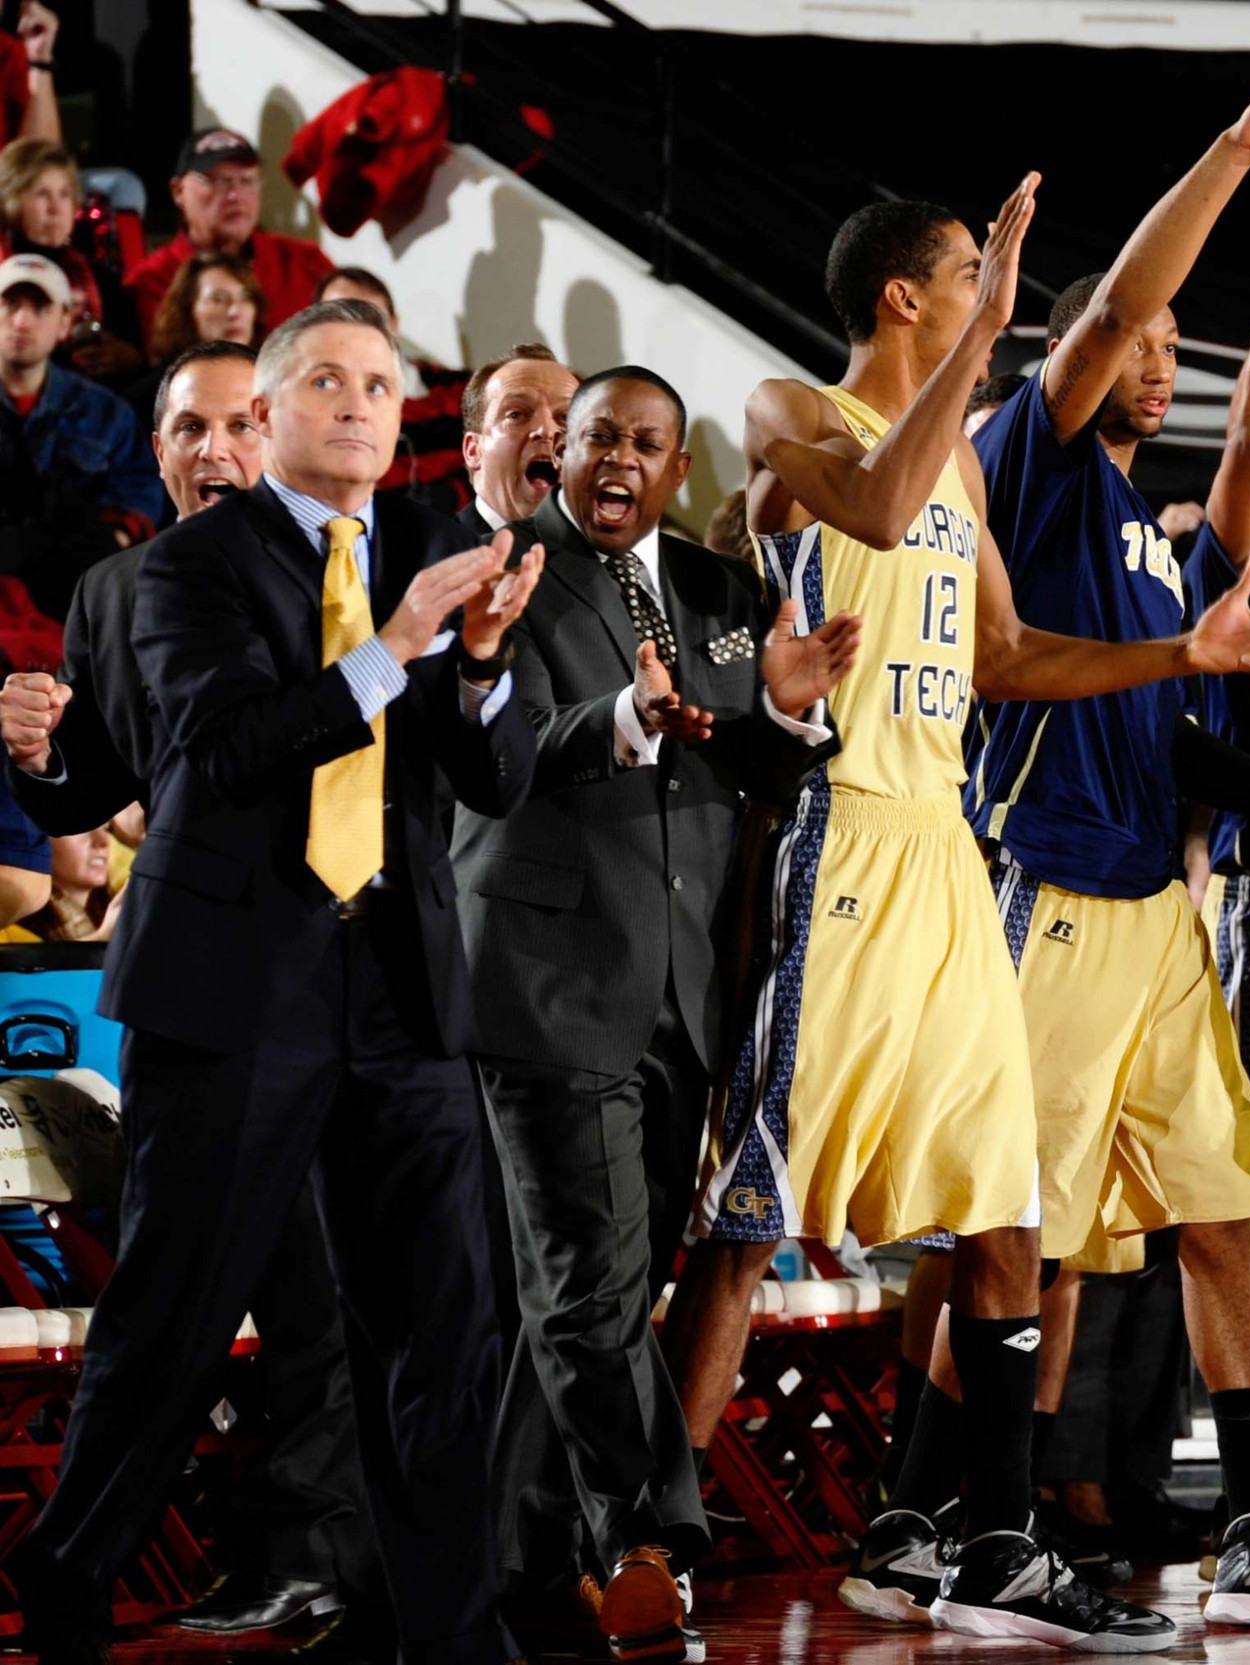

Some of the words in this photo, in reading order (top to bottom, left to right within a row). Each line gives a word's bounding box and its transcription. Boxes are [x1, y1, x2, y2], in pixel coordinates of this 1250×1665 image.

[920, 572, 959, 645] 12
[886, 662, 972, 726] TECH
[726, 1186, 775, 1219] GT
